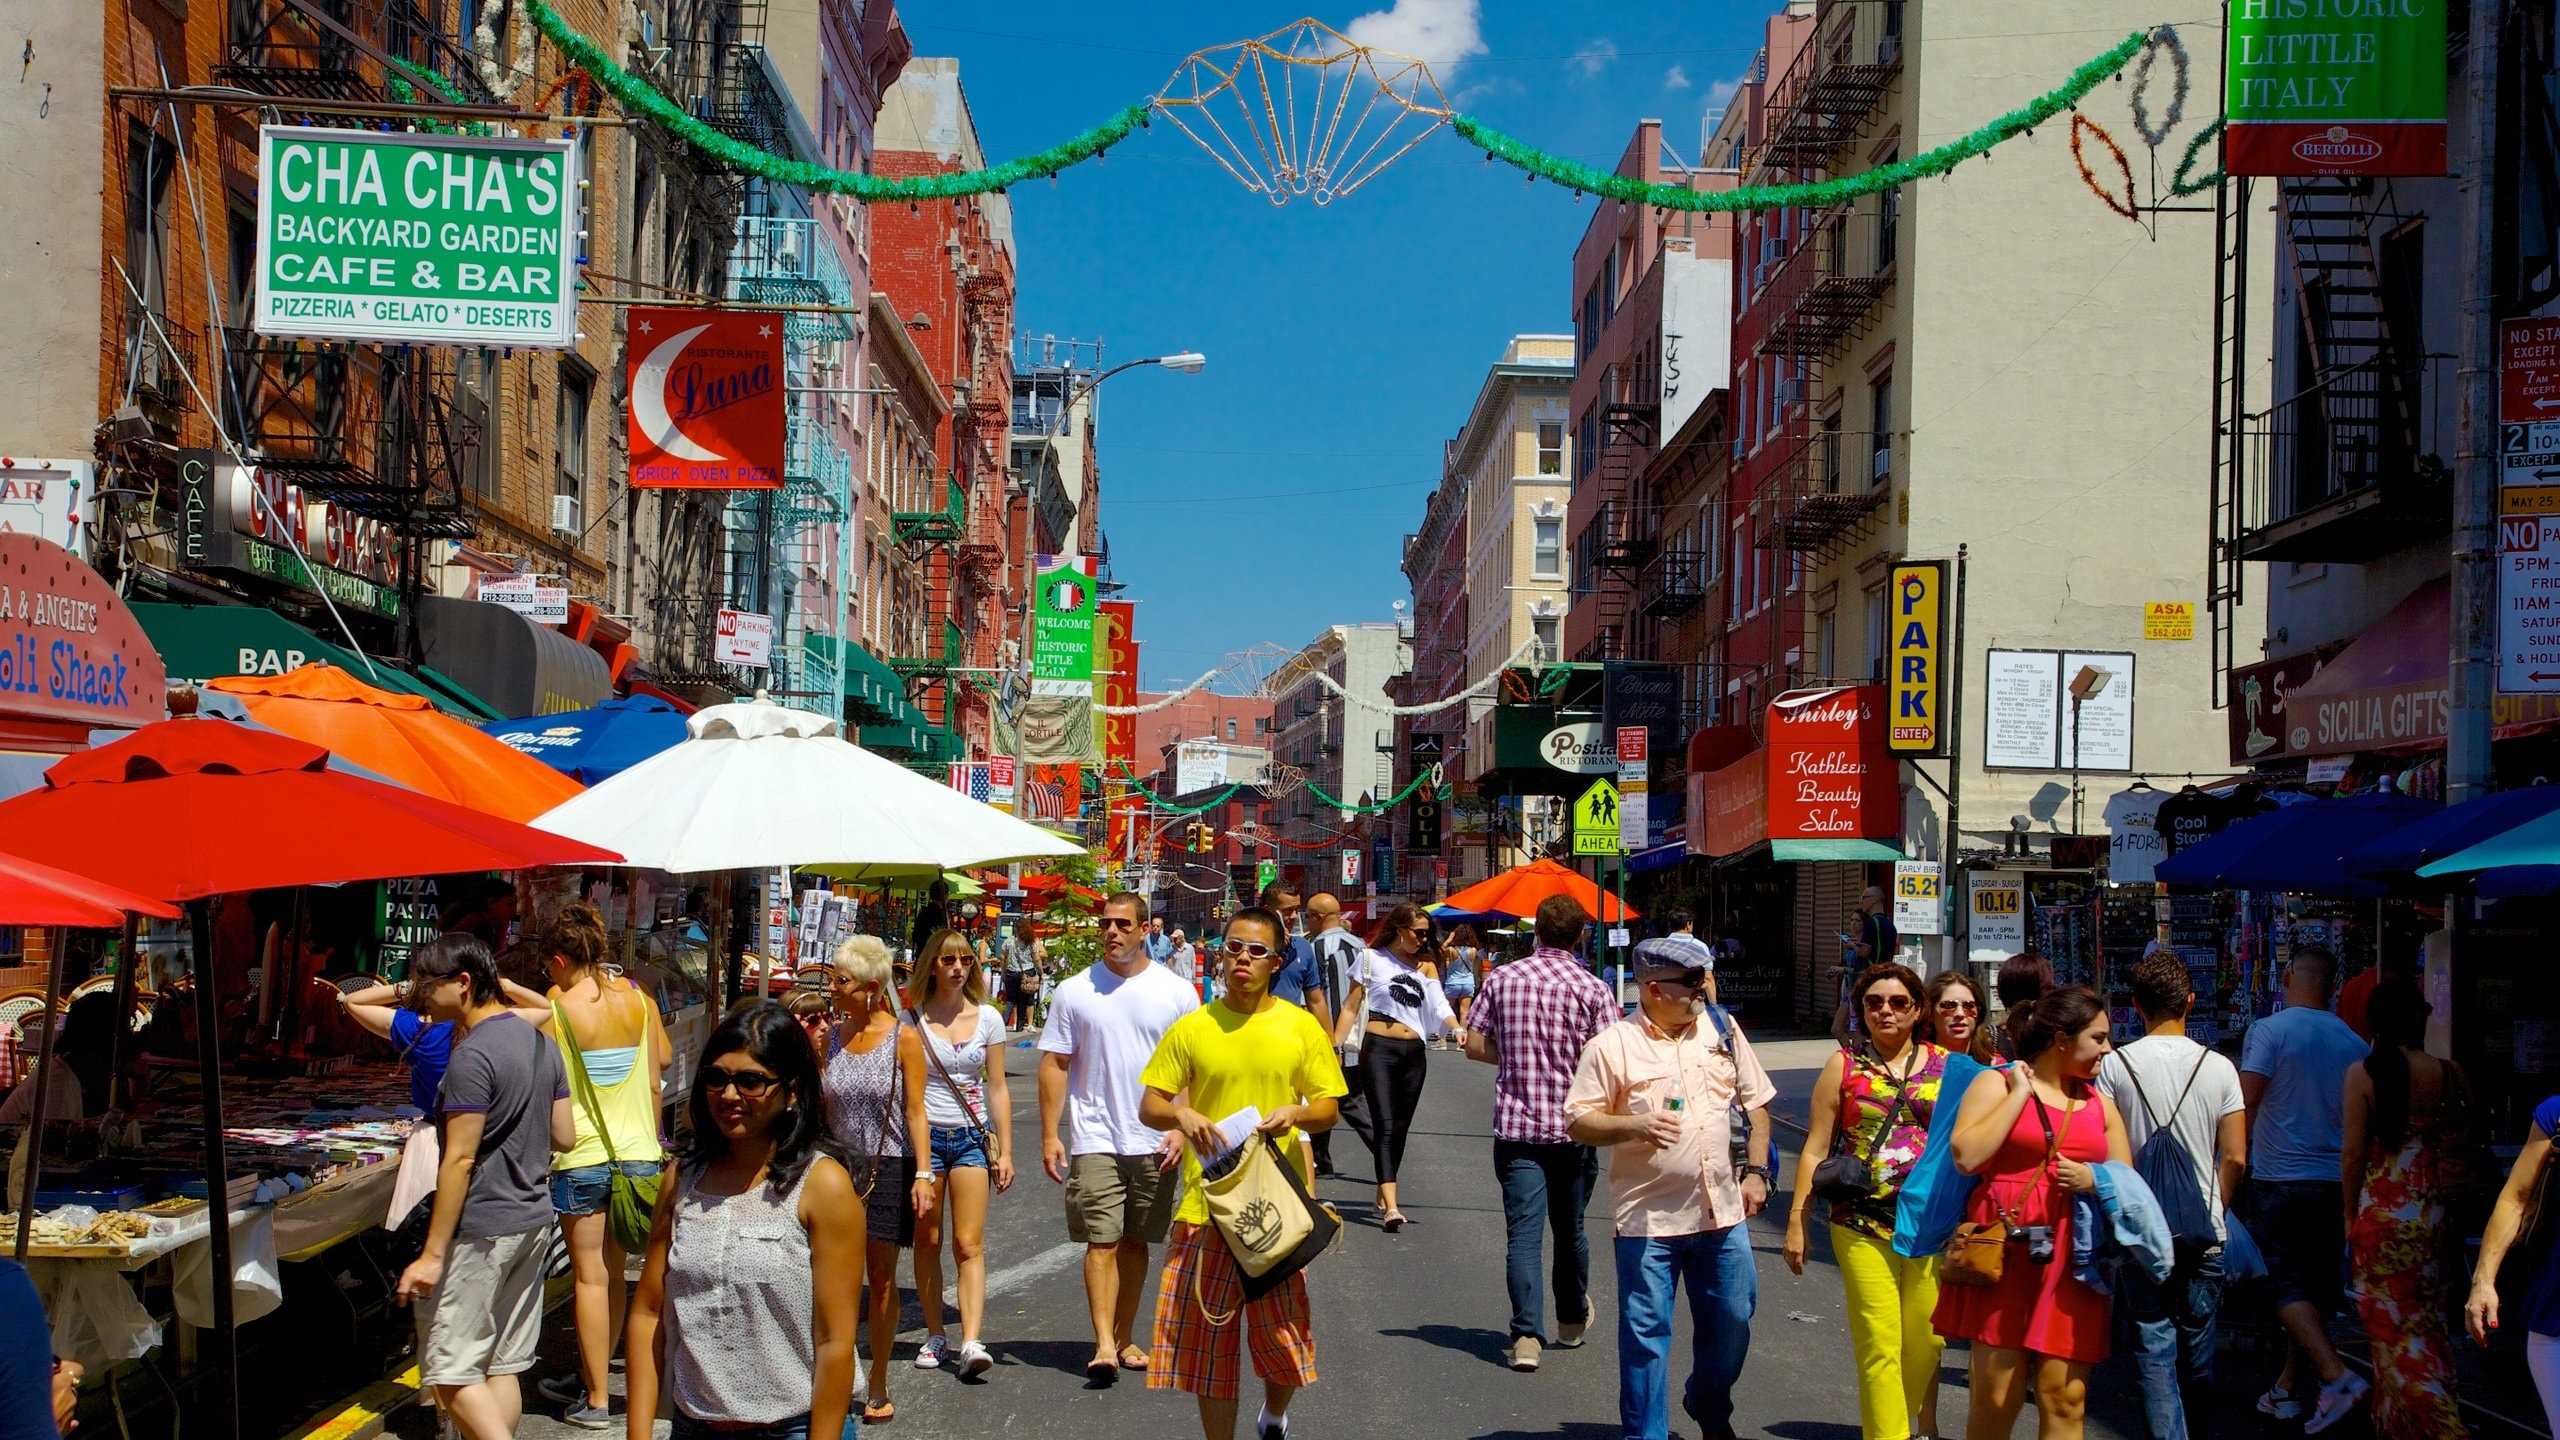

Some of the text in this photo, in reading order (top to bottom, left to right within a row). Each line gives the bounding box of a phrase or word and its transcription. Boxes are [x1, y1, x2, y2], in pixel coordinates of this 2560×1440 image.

[2242, 0, 2424, 20] HISTORIC
[2240, 33, 2376, 65] LITTLE
[2240, 77, 2354, 108] ITALY
[2302, 144, 2373, 156] BERTOLLI
[279, 144, 557, 216] CHA CHA'S
[278, 214, 557, 256] BACKYARD GARDEN
[275, 254, 552, 294] CAFE & BAR
[272, 298, 355, 319] PIZZERIA
[374, 302, 448, 323] GELATO
[466, 306, 552, 328] DESERTS
[2511, 329, 2530, 343] NO
[688, 348, 769, 360] RISTORANTE
[2514, 346, 2556, 358] EXCEPT
[1664, 333, 1684, 398] TUSH
[2508, 358, 2556, 369] LOADING &
[672, 362, 774, 417] Luna
[2523, 386, 2556, 396] EXCEPT
[2508, 424, 2524, 450] 2
[2512, 455, 2556, 466] EXCEPT
[636, 466, 778, 481] BRICK OVEN PIZZA
[182, 459, 208, 558] CAFE
[2512, 496, 2554, 508] MAY 25
[233, 466, 399, 587] CHA CHA'S
[2502, 521, 2538, 550] NO
[2514, 558, 2550, 572] 5PM
[484, 576, 532, 584] APARTMENT
[484, 593, 532, 602] 212-228-9300
[2514, 597, 2550, 610] 11AM
[18, 590, 28, 620] &
[34, 592, 97, 634] ANGIE'S
[2154, 604, 2185, 614] ASA
[720, 615, 769, 634] NO PARKING
[1038, 617, 1090, 630] WELCOME
[1037, 630, 1050, 640] TO
[2153, 628, 2192, 637] 562-2047
[728, 638, 760, 650] ANYTIME
[1036, 642, 1087, 653] HISTORIC
[1899, 577, 1930, 718] PARK
[239, 648, 306, 676] BAR
[1036, 654, 1072, 666] LITTLE
[2516, 654, 2526, 664] &
[50, 638, 128, 708] Shack
[1036, 666, 1067, 678] ITALY
[1784, 701, 1872, 730] Shirley's
[2318, 688, 2451, 745] SICILIA GIFTS
[1038, 720, 1046, 728] IL
[496, 731, 582, 747] Corona
[1894, 728, 1930, 739] ENTER
[2294, 730, 2307, 744] 112
[1786, 752, 1868, 776] Kathleen
[1796, 780, 1862, 809] Beauty
[1799, 809, 1854, 832] Salon
[2174, 815, 2207, 830] Cool
[2112, 834, 2124, 852] 4
[1346, 856, 1358, 879] GIFT
[1898, 865, 1942, 874] EARLY BIRD
[386, 878, 438, 896] PIZZA
[1900, 877, 1940, 896] 15.21
[1972, 880, 2022, 888] SATURDAY SUNDAY
[1004, 901, 1012, 912] P
[1977, 892, 2016, 912] 10.14
